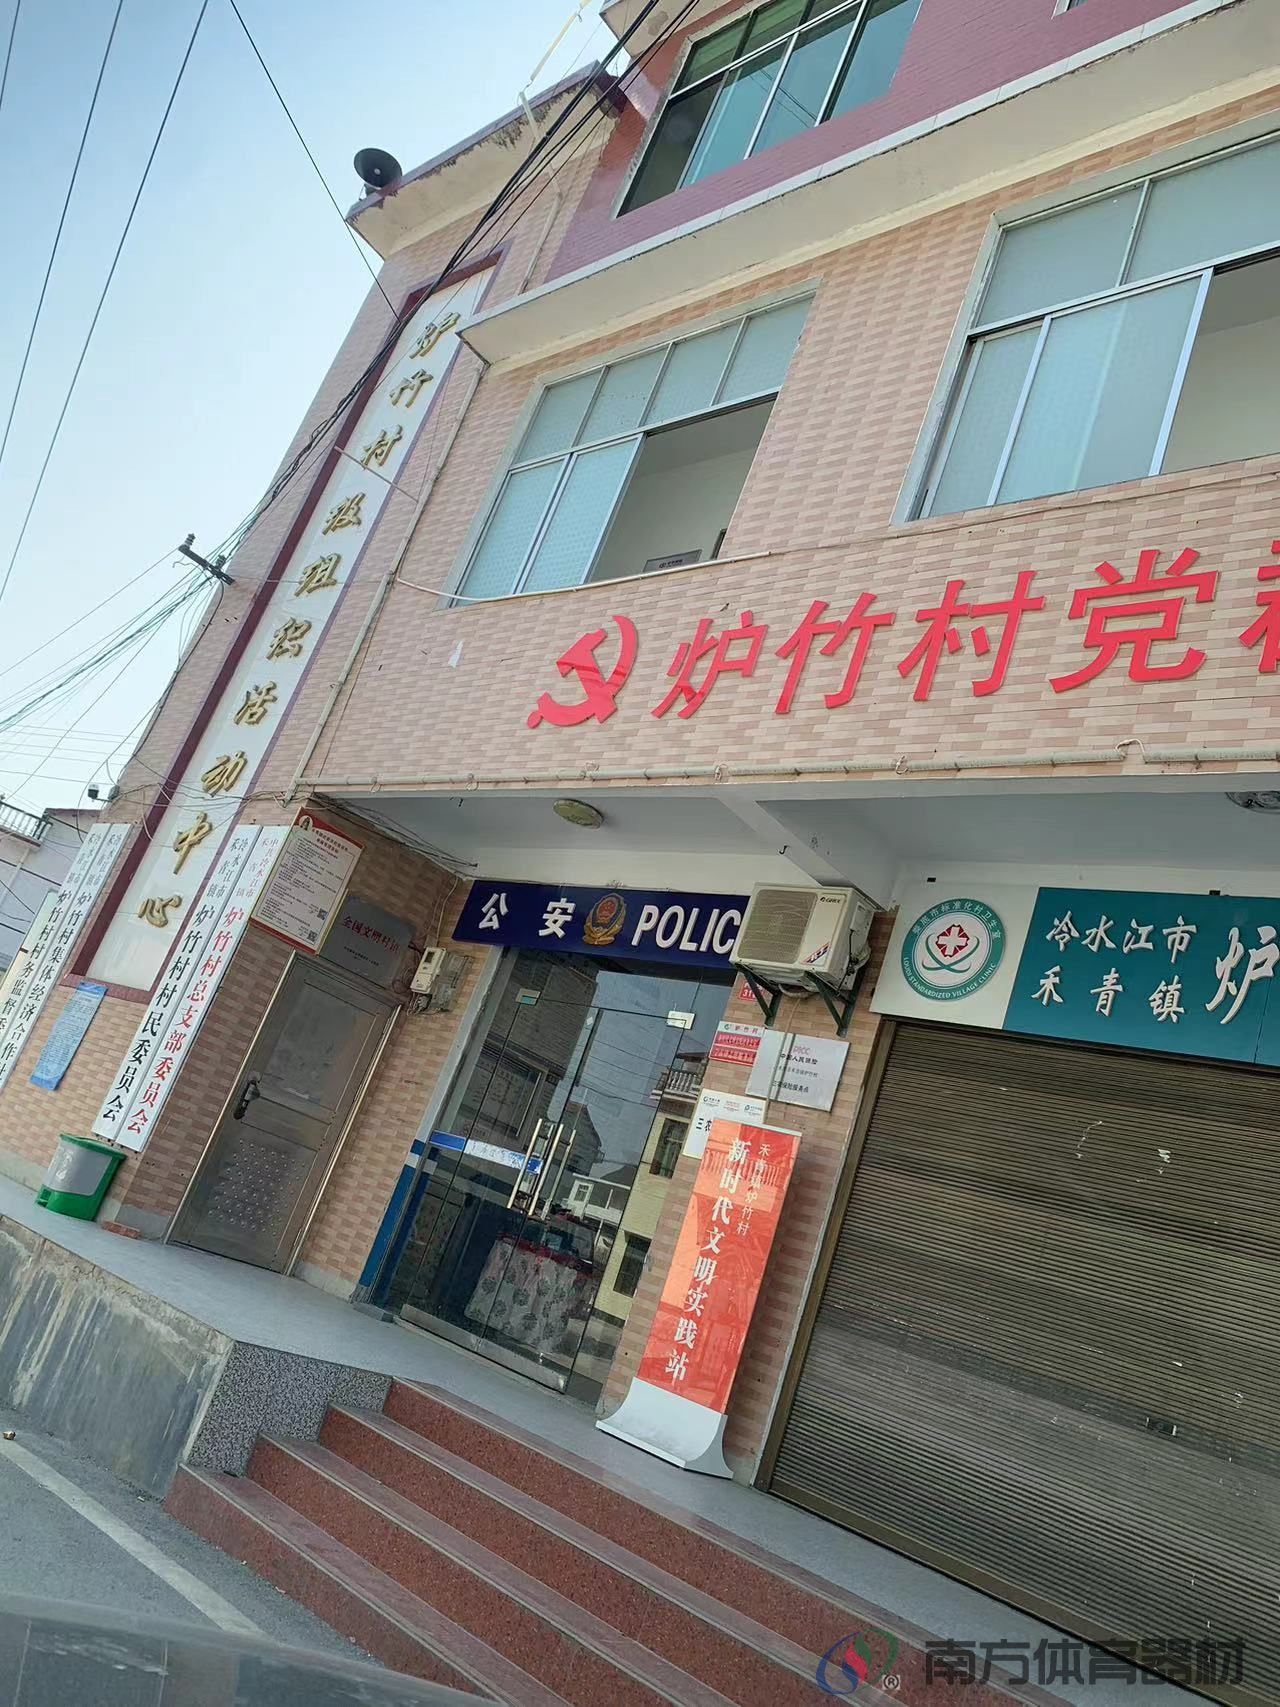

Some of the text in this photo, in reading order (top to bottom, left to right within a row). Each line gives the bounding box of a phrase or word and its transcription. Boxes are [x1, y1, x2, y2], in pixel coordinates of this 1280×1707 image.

[138, 311, 461, 929] 炉竹村级组织活动中心
[478, 892, 576, 939] 公安
[631, 904, 742, 955] POLIC
[1046, 910, 1198, 964] 冷水江市
[103, 904, 215, 1122] 炉竹村村民委员会
[951, 982, 978, 996] VILLAGE
[978, 963, 996, 984] CLINIC
[1031, 965, 1186, 1024] 禾青镇
[1205, 926, 1280, 1024] 炉
[127, 906, 244, 1134] 炉竹村总支部委员会
[665, 1137, 751, 1385] 新时代文明实践站
